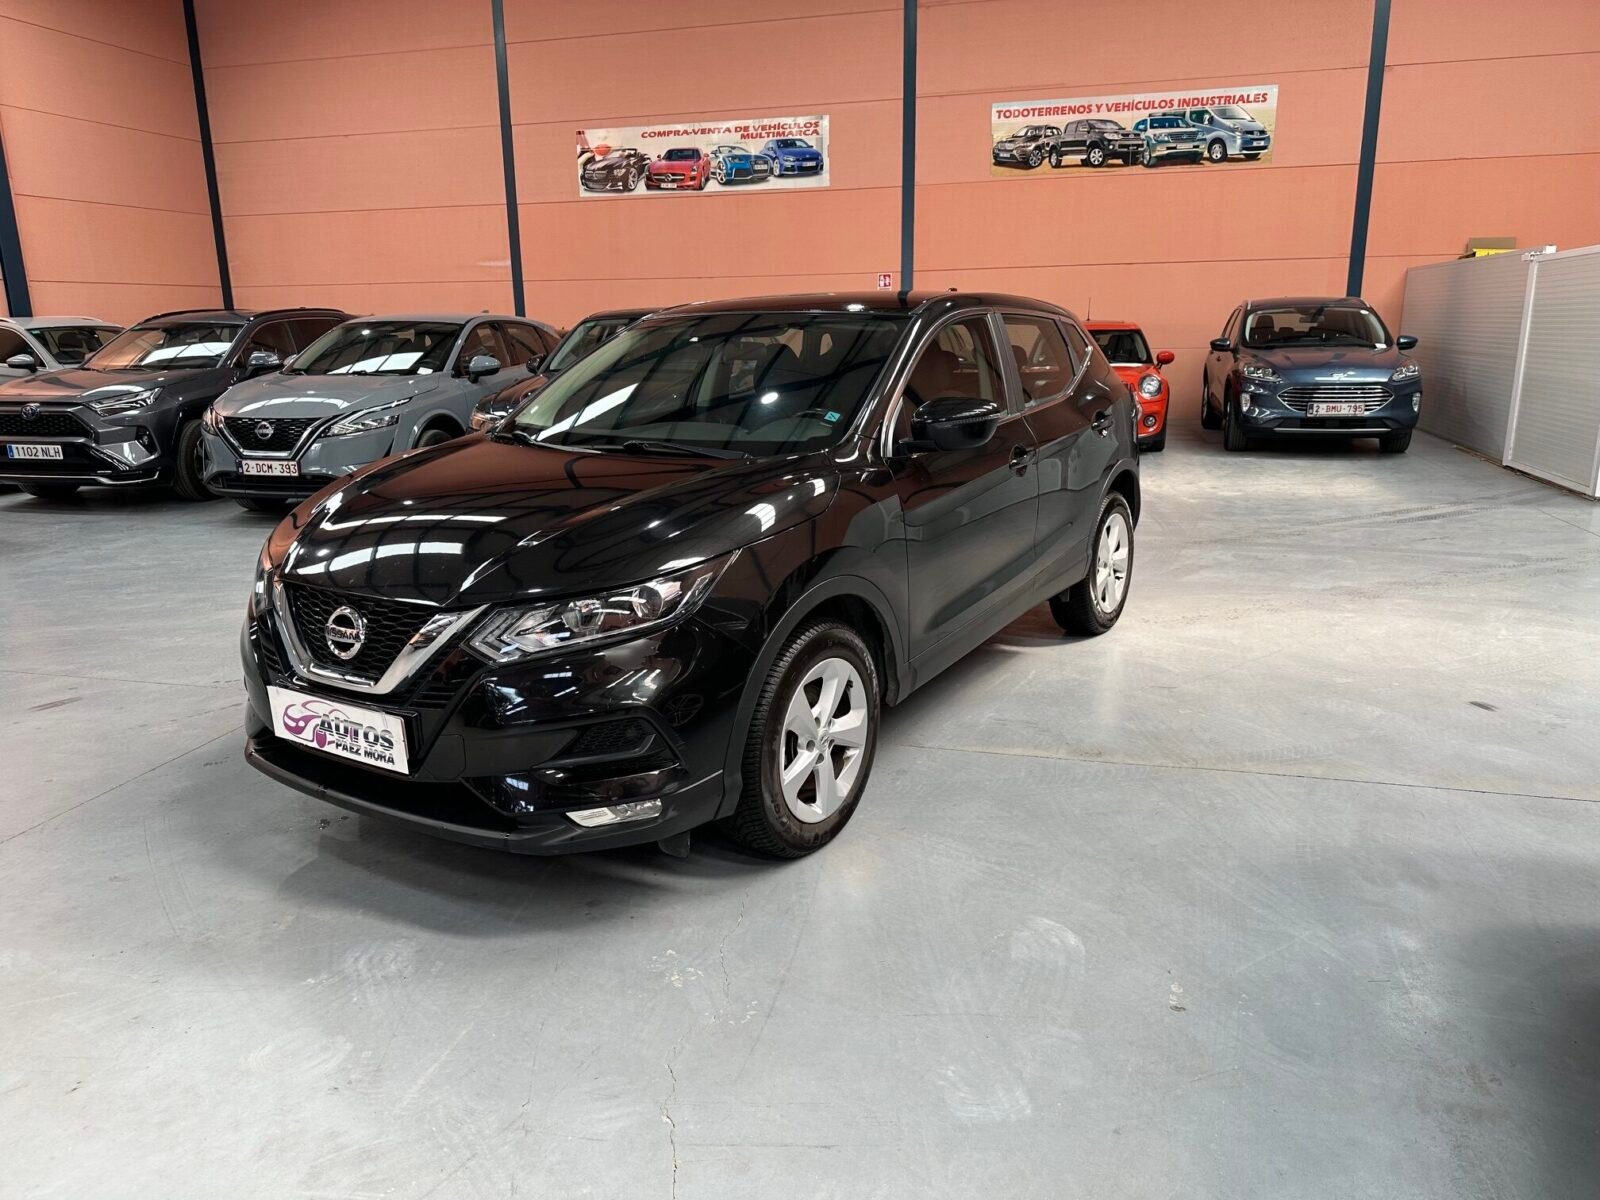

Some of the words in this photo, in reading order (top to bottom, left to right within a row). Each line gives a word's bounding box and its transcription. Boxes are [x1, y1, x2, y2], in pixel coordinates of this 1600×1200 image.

[996, 104, 1092, 119] TODOTERRENOS
[1096, 104, 1103, 113] Y
[1106, 99, 1174, 113] VEHÍCULOS
[1178, 92, 1268, 108] INDUSTRIALES
[641, 127, 732, 139] COMPRA-VENTA
[734, 125, 750, 133] DE
[753, 121, 820, 132] VEHÍCULOS
[740, 129, 820, 140] MULTIMARCA
[15, 446, 40, 458] 1102
[40, 446, 61, 458] NLH
[244, 462, 297, 474] 2-DCM-393
[326, 625, 361, 641] NISSAN
[319, 713, 394, 752] AUTOS
[335, 738, 362, 756] PAEZ
[363, 746, 396, 766] MORA
